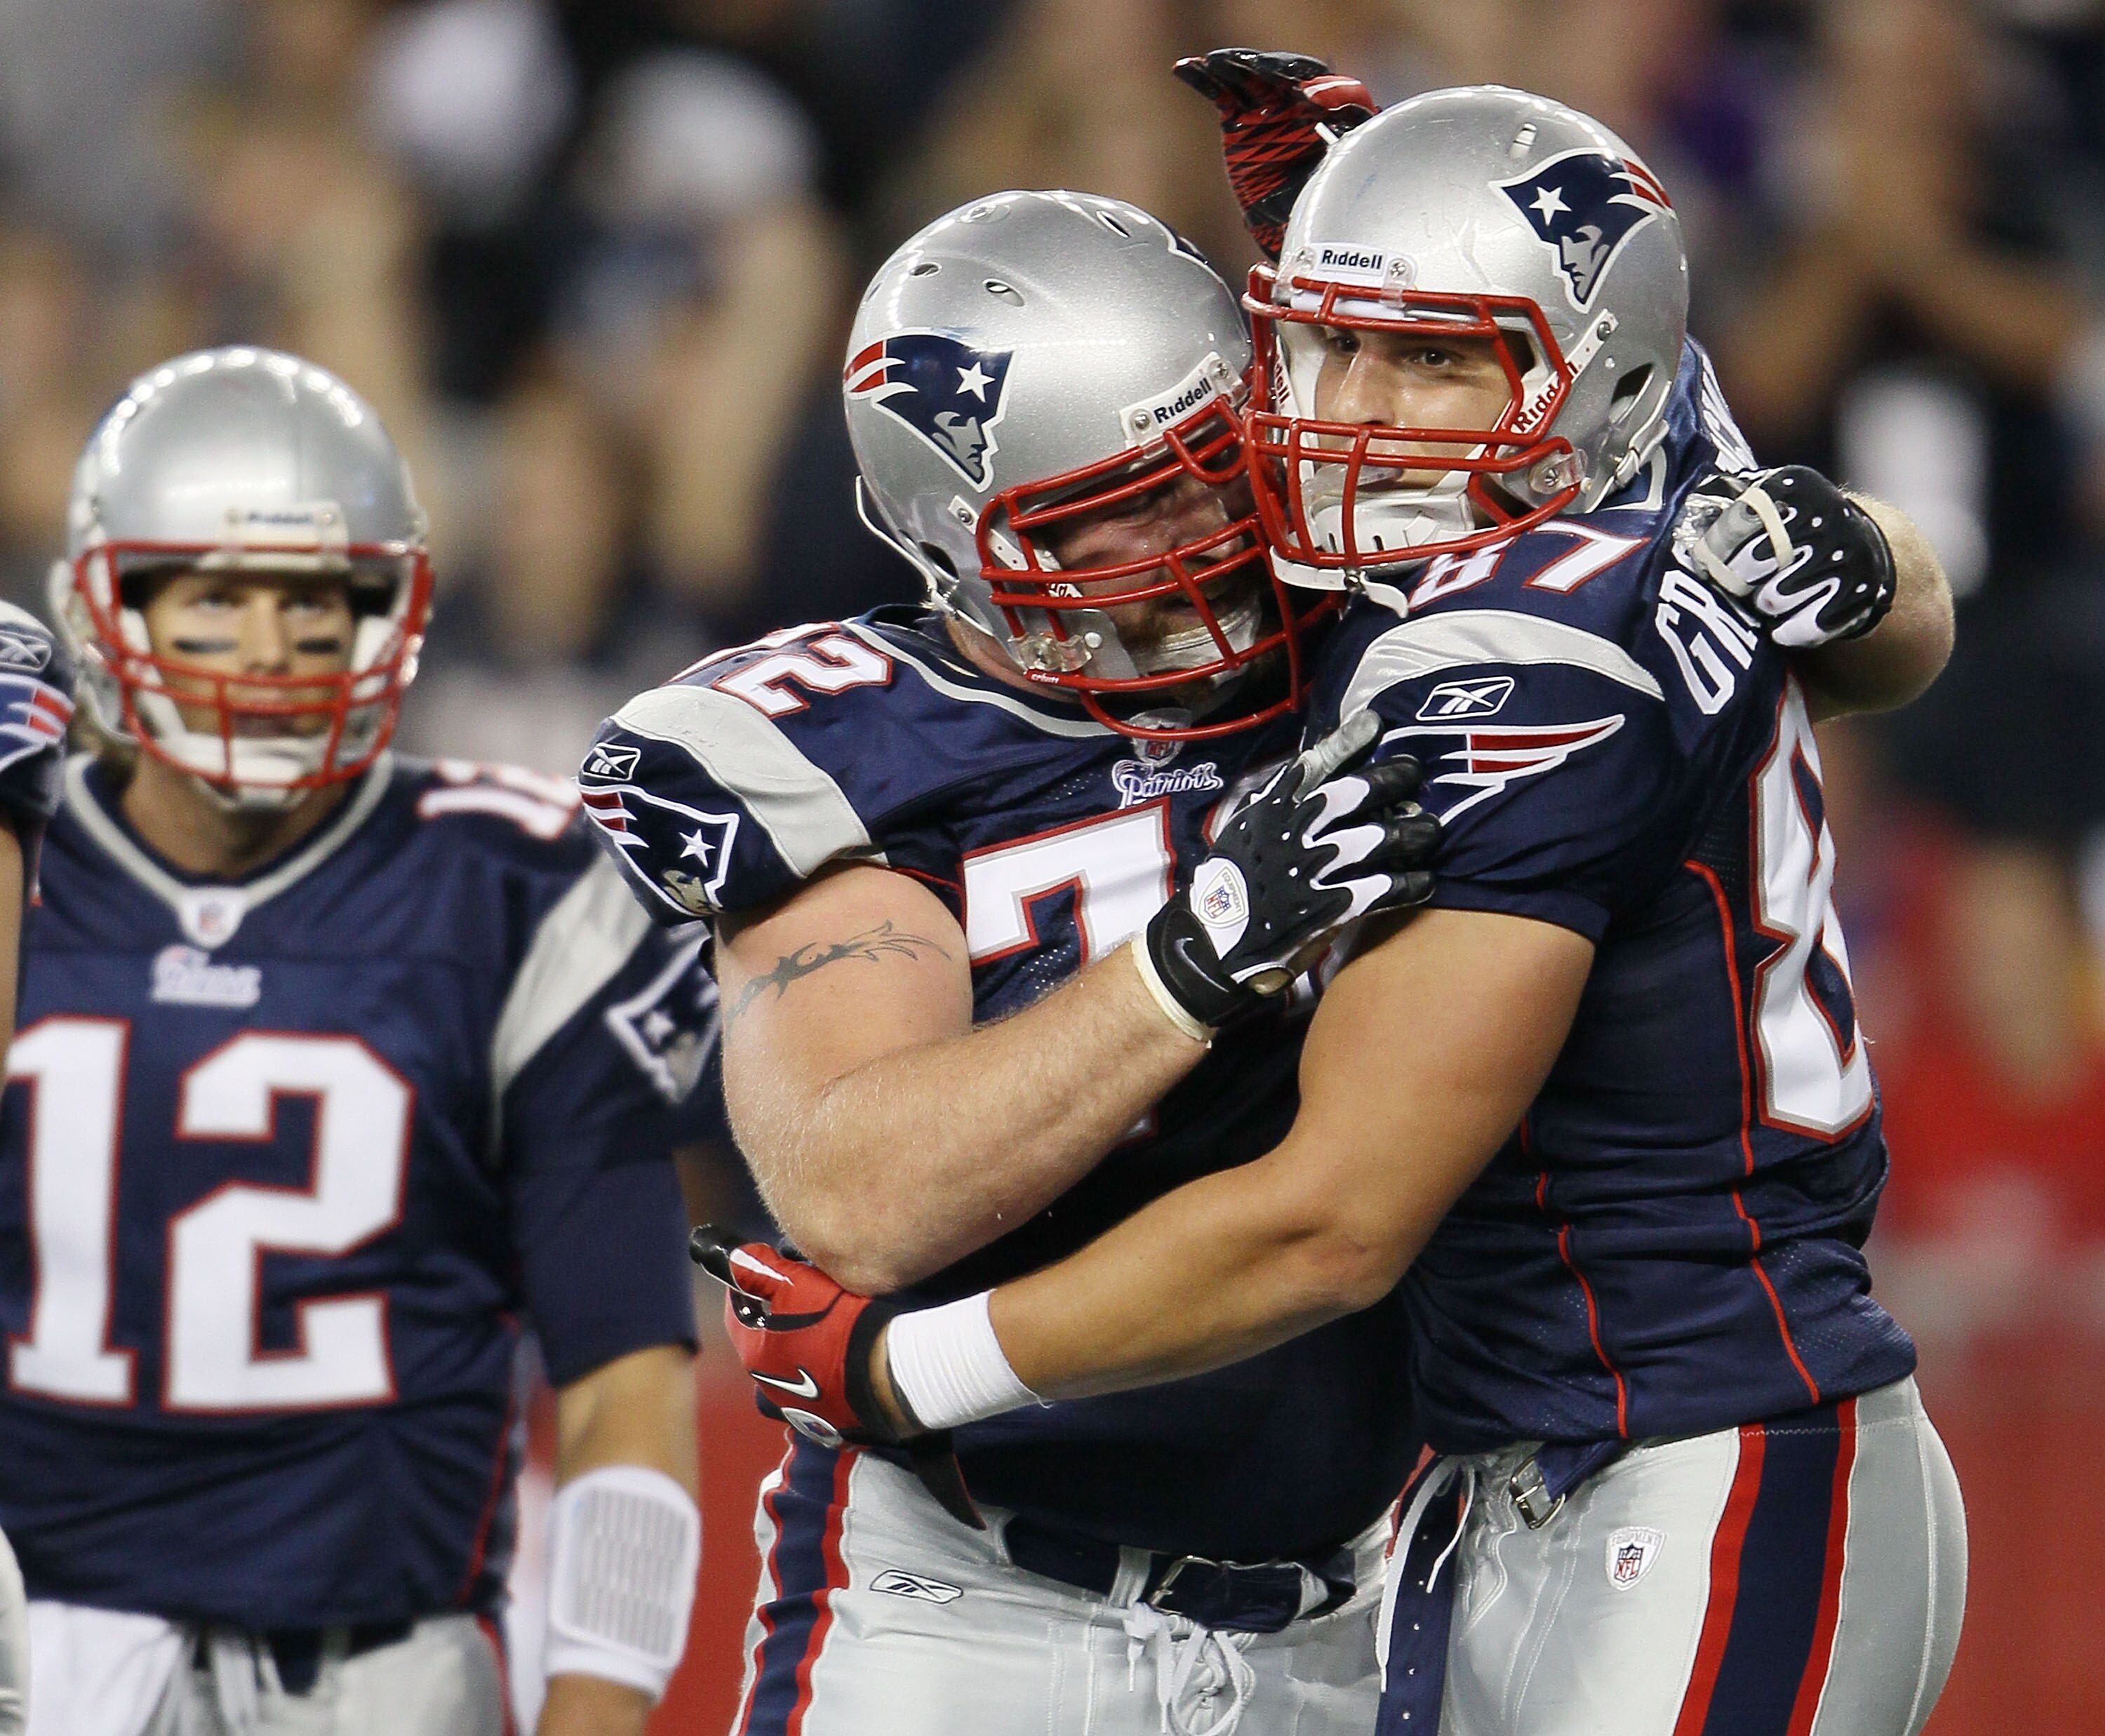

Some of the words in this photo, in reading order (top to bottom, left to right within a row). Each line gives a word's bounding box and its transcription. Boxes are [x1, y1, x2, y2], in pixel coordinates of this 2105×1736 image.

[1322, 250, 1383, 269] Riddell
[1154, 378, 1212, 424] Riddell
[1516, 361, 1579, 433] Riddl
[1111, 761, 1224, 809] Patriots
[1206, 893, 1223, 919] NFL
[1, 1014, 415, 1415] 12
[1616, 1558, 1637, 1579] NFL
